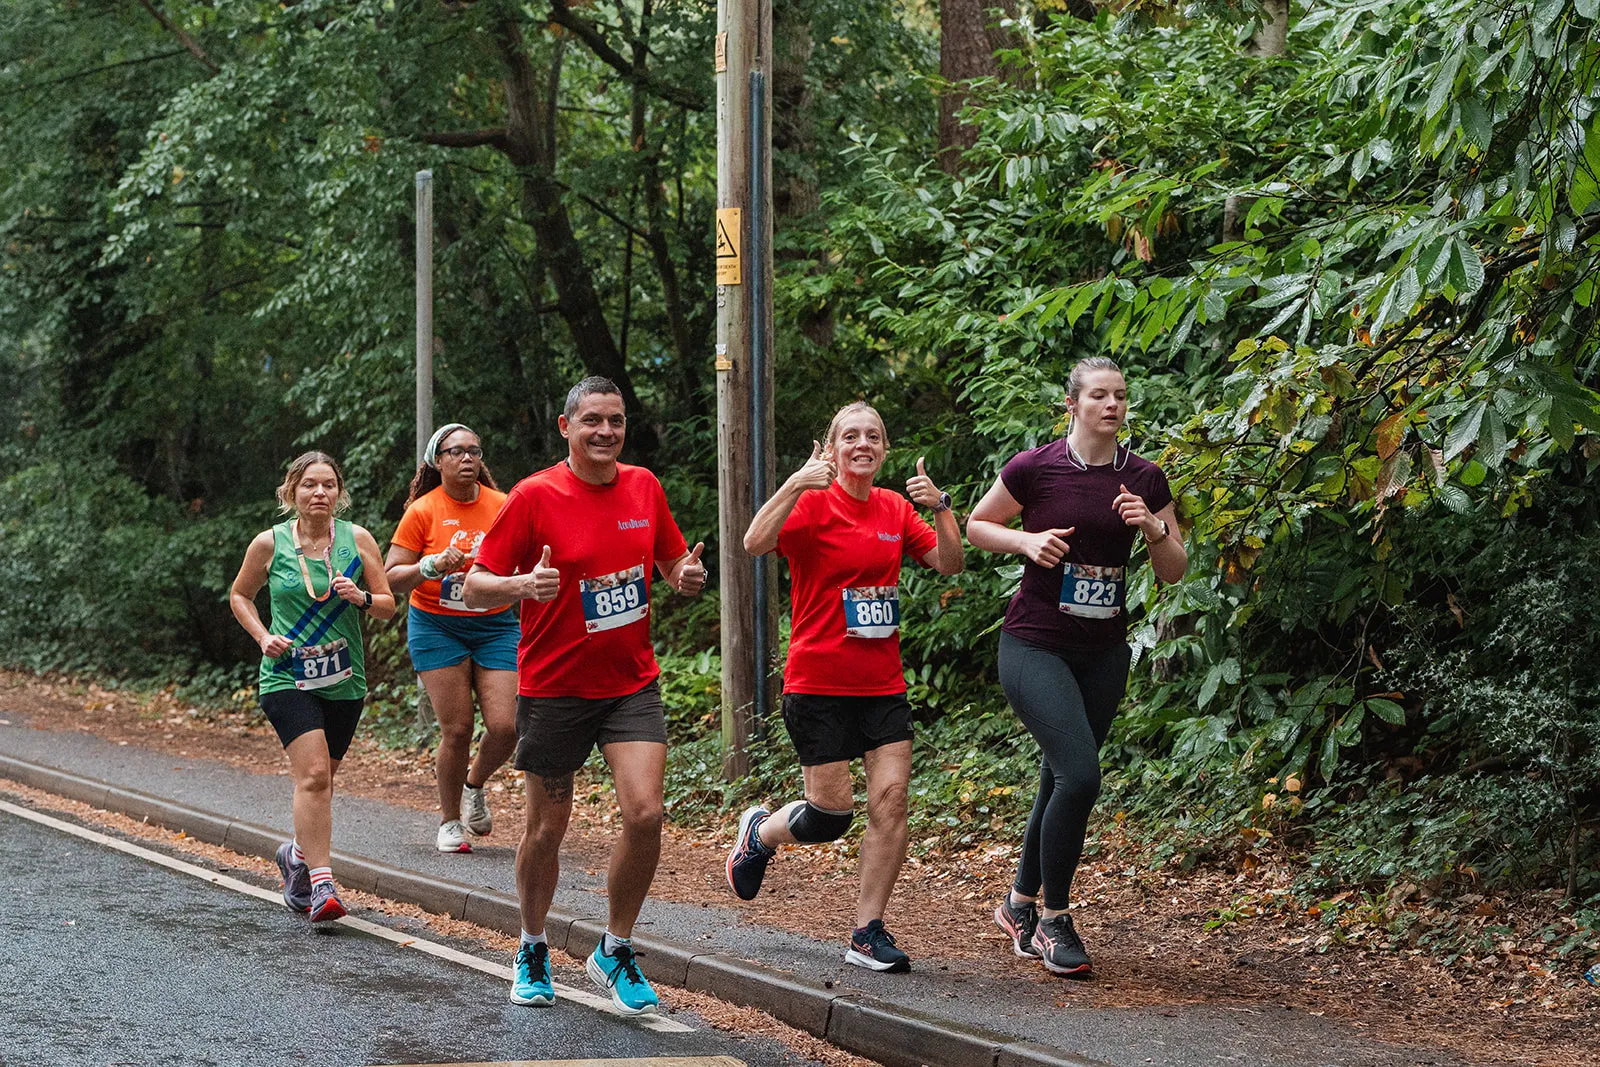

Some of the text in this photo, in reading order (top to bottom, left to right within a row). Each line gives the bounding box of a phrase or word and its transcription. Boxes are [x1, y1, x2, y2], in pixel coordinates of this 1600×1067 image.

[595, 583, 639, 616] 859
[1073, 580, 1117, 606] 823
[856, 601, 893, 625] 860
[303, 652, 341, 679] 871
